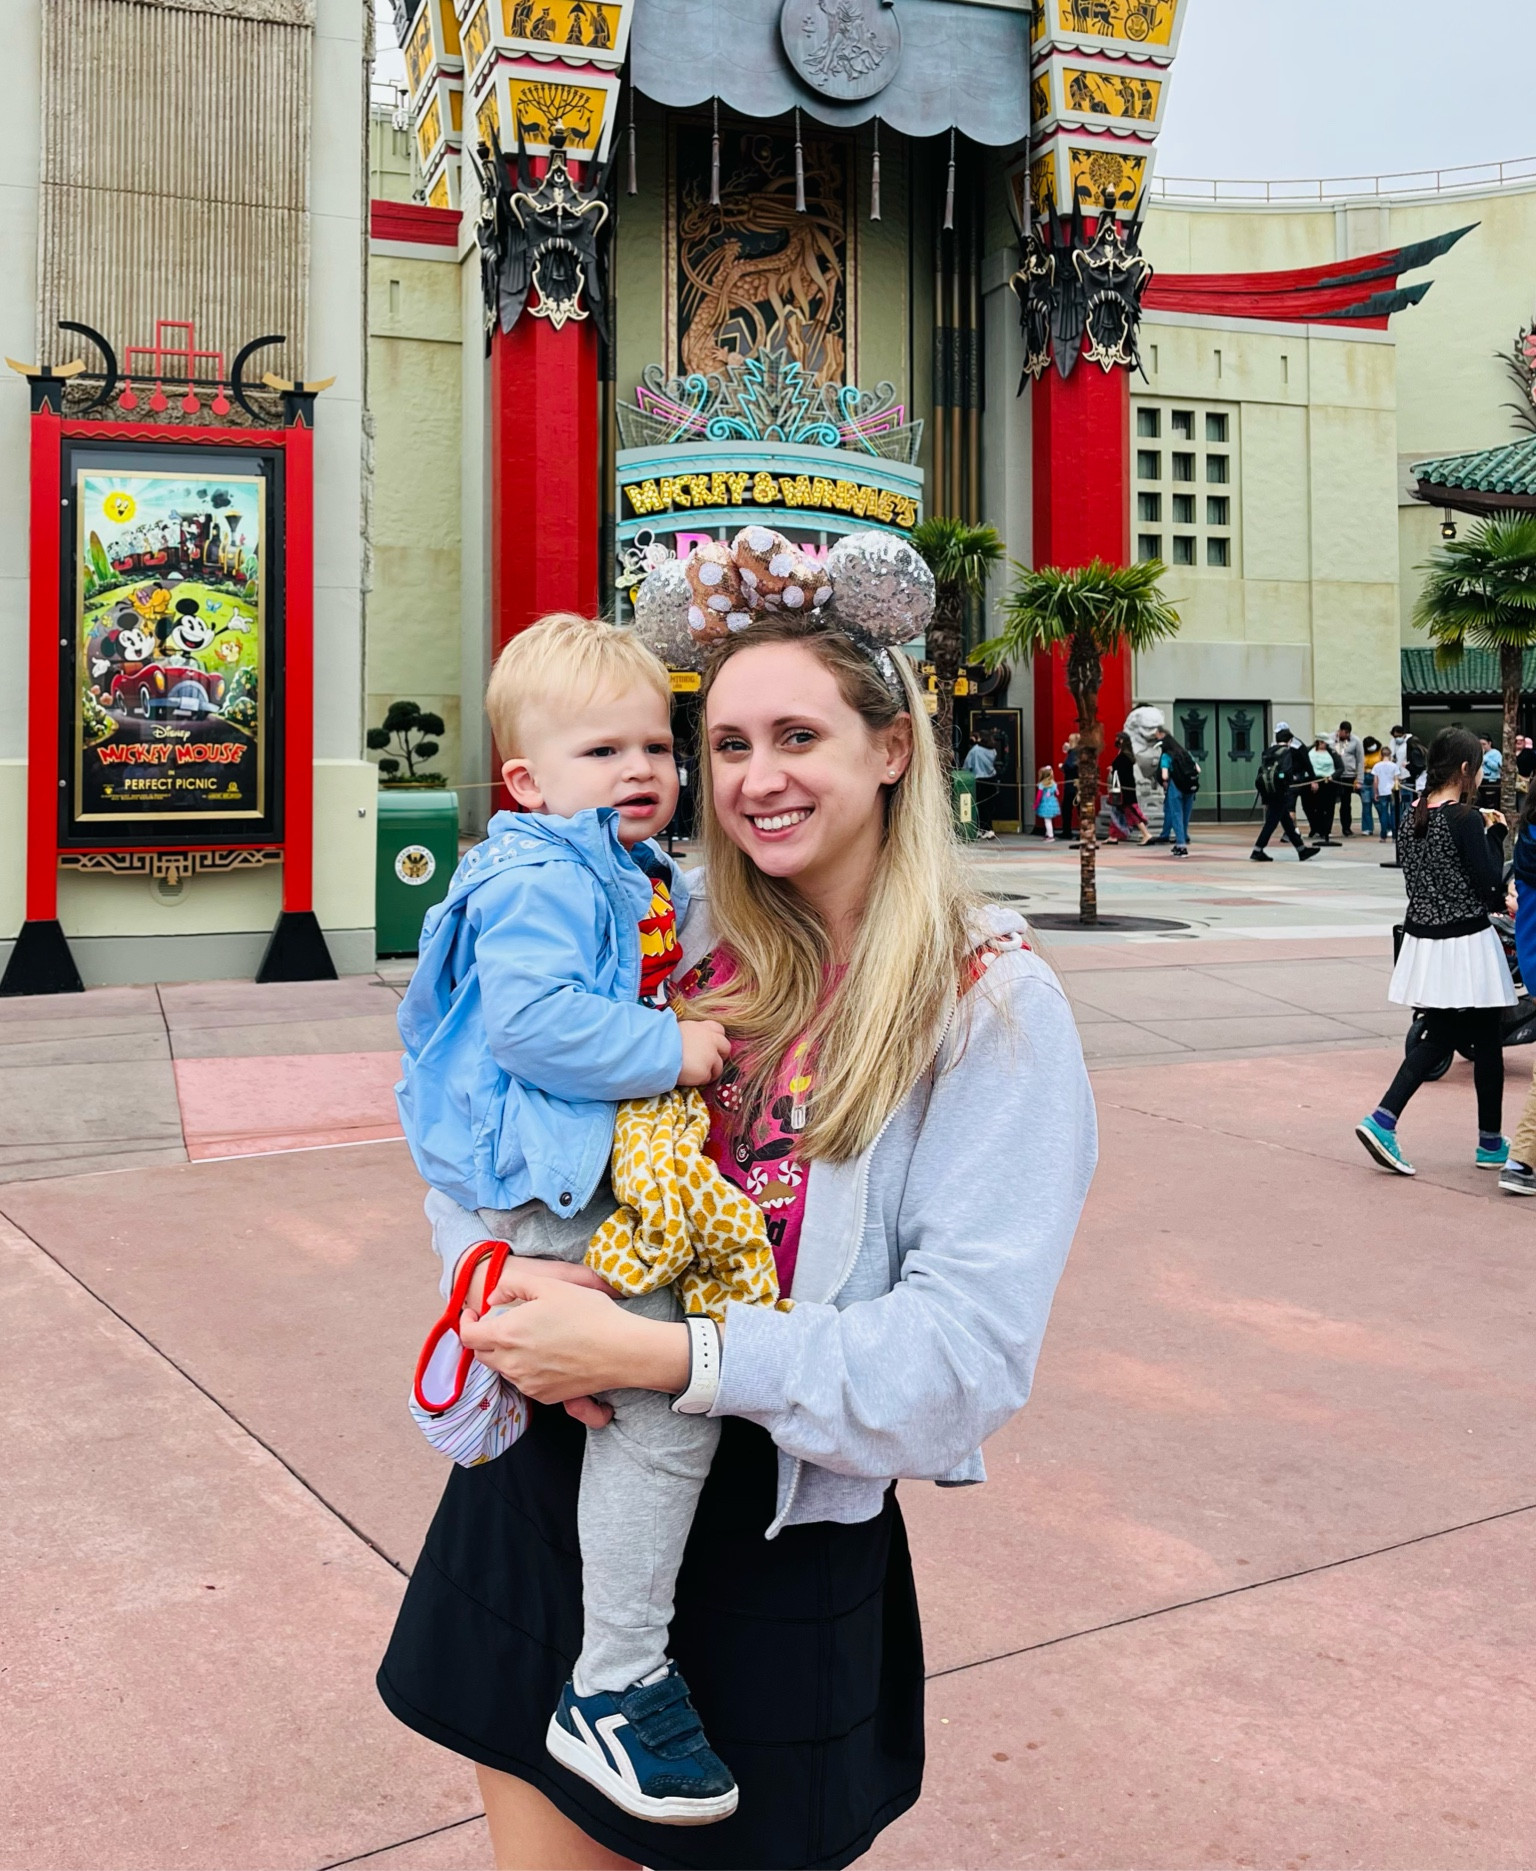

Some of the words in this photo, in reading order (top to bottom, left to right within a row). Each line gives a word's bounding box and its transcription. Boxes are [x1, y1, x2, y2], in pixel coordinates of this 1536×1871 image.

[624, 472, 749, 514] MICKEY
[752, 472, 778, 504] &
[778, 475, 918, 527] MINNIE'S
[151, 725, 191, 742] Disney
[97, 743, 173, 765] MICKEY
[175, 743, 247, 764] MOUSE
[124, 778, 172, 791] PERFECT
[175, 778, 217, 790] PICNIC
